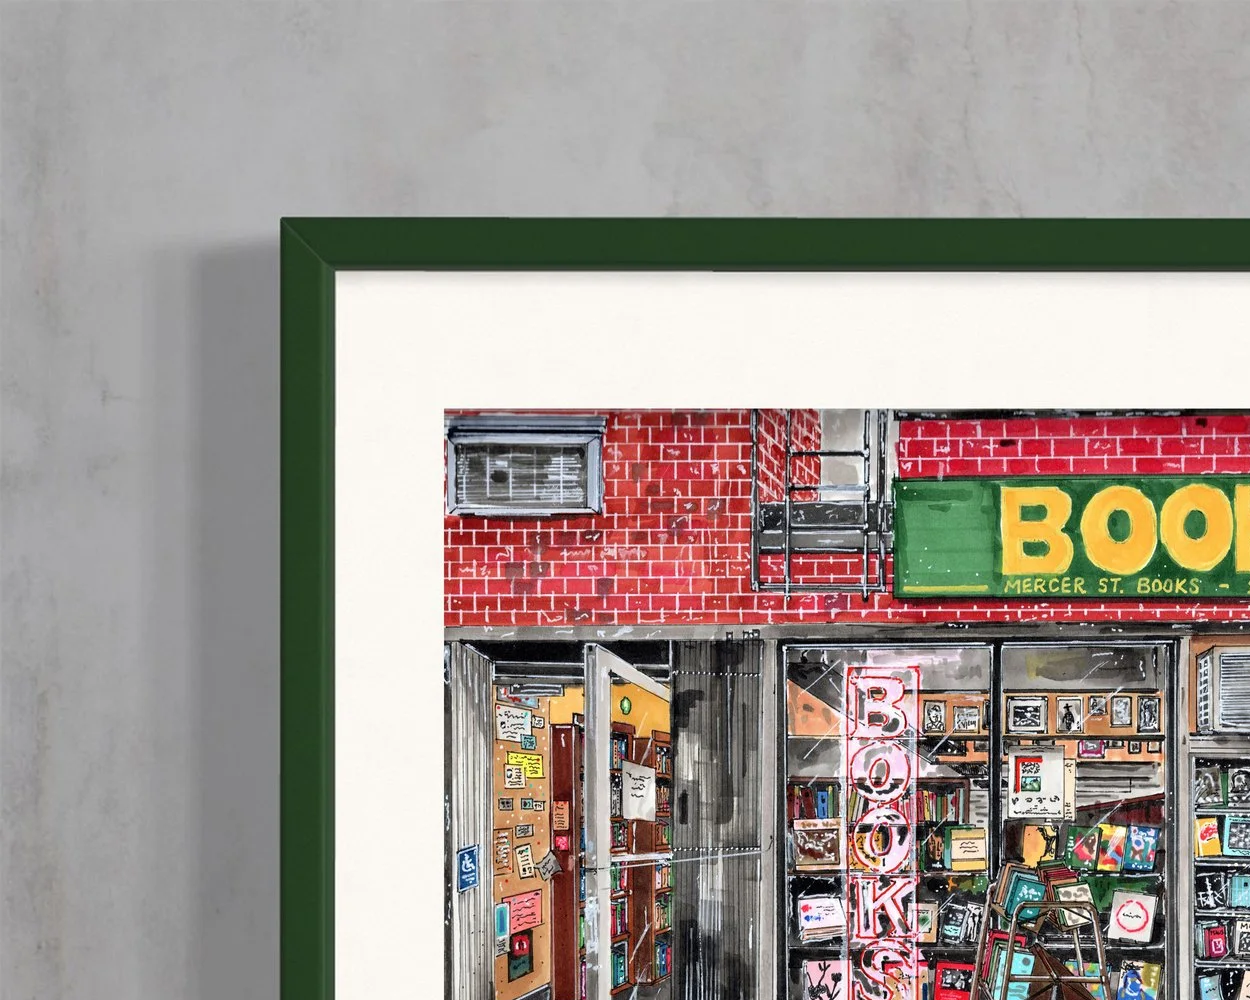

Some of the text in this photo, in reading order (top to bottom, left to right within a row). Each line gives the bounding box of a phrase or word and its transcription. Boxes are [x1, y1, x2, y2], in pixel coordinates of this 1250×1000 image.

[1004, 577, 1087, 595] MERCER
[1098, 577, 1125, 594] ST.
[1137, 577, 1200, 595] BOOKS
